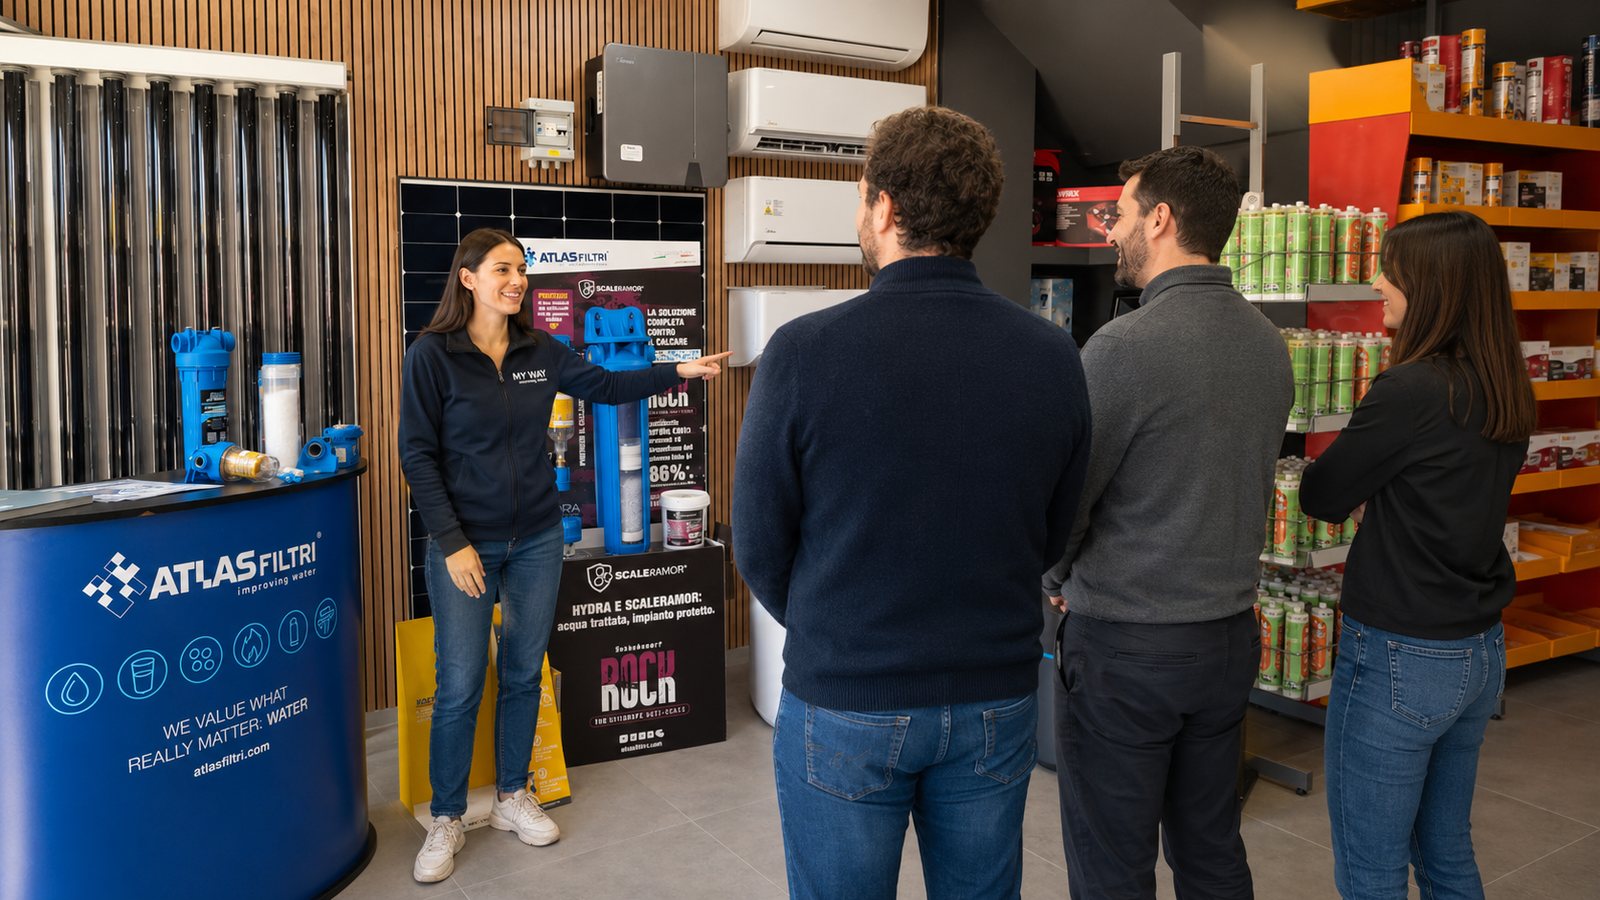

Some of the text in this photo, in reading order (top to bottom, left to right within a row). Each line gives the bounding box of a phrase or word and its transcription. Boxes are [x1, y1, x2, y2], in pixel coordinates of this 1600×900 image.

[646, 318, 685, 327] COMPLETA
[647, 308, 697, 317] LA SOLUZIONE
[647, 328, 676, 337] CONTRO
[655, 337, 689, 346] CALCARE
[512, 369, 546, 380] MY WAY
[559, 503, 581, 513] RA
[237, 568, 317, 596] improving water
[572, 592, 702, 617] HYDRA E SCALERAMOR:
[557, 605, 715, 633] acqua trattata, impianto protetto.
[600, 649, 676, 712] ROCK
[163, 686, 288, 740] WE VALUE WHAT
[128, 697, 309, 773] REALLY MATTER: WATER
[193, 742, 270, 778] atlasfiltri.com
